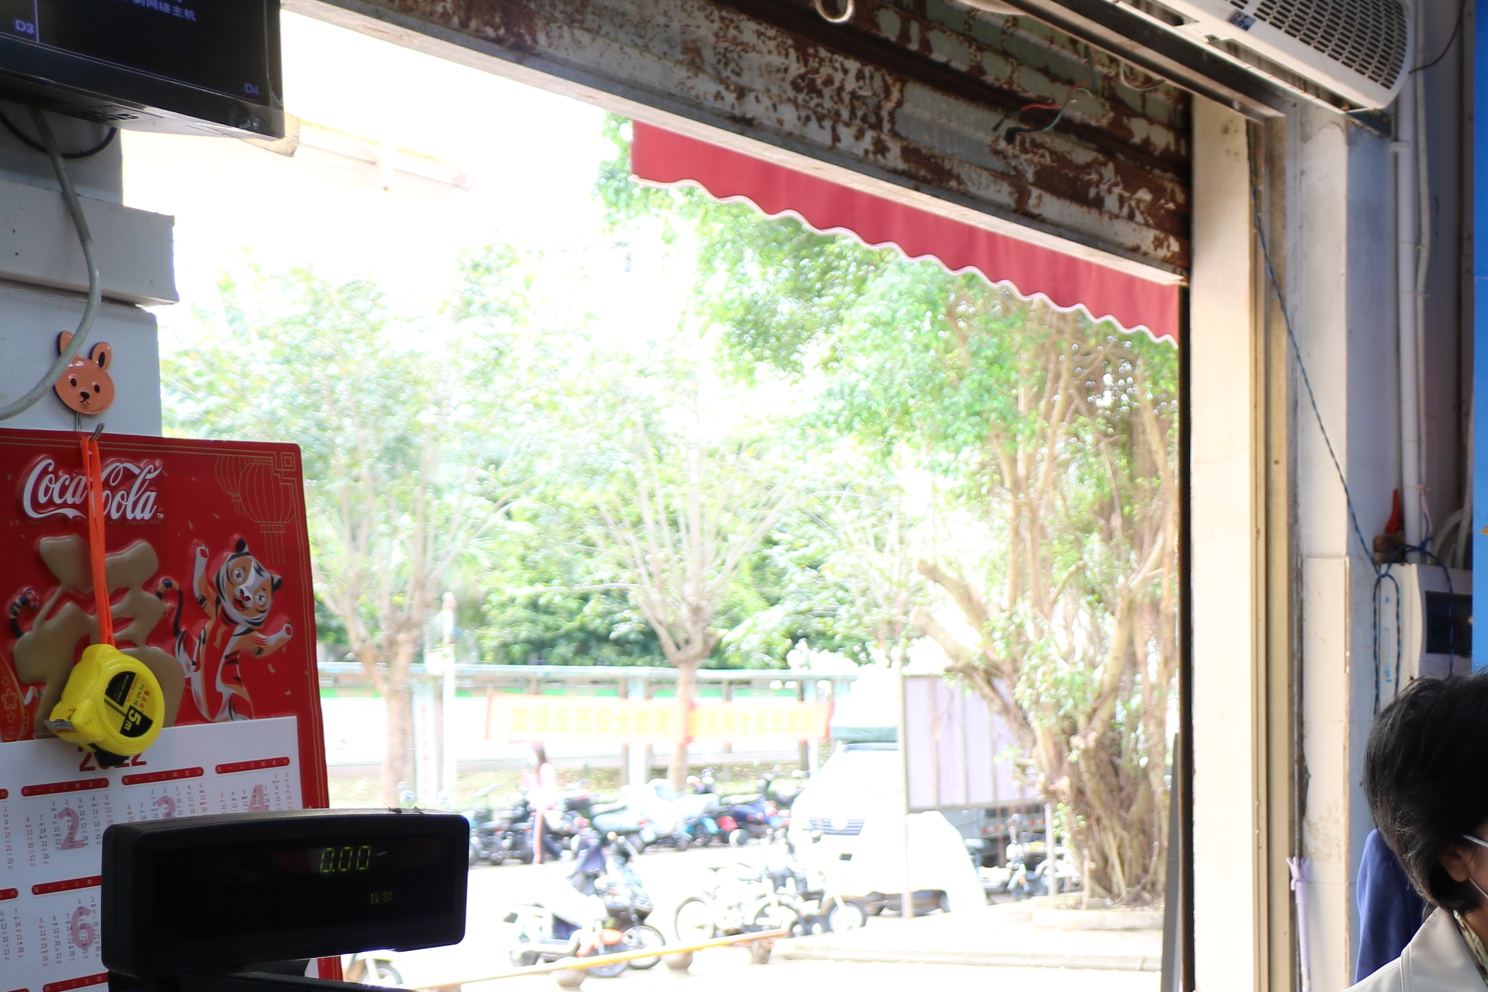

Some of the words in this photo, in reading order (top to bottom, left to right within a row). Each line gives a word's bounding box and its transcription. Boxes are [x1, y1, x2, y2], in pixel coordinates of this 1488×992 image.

[14, 19, 35, 34] D3
[244, 82, 260, 95] D4
[123, 709, 142, 731] 5m
[320, 845, 371, 873] 0.00
